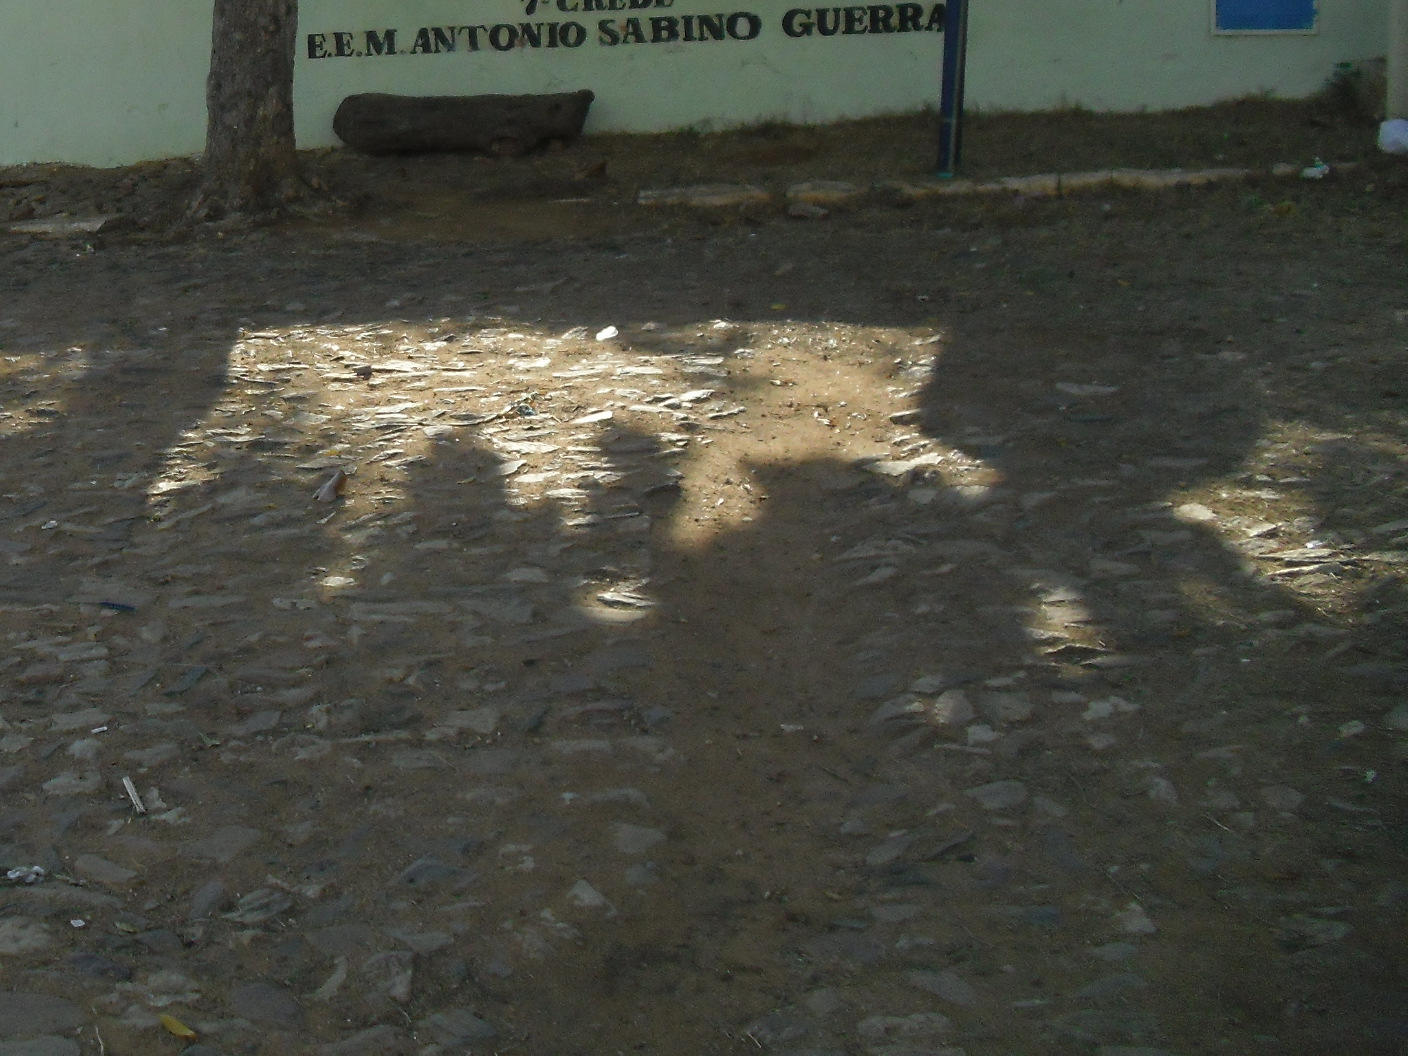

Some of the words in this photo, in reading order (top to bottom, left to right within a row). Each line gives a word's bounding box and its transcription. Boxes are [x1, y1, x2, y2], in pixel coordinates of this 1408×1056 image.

[410, 21, 588, 54] ANTONIO
[598, 11, 763, 47] SABINO
[781, 2, 947, 39] GUERRA
